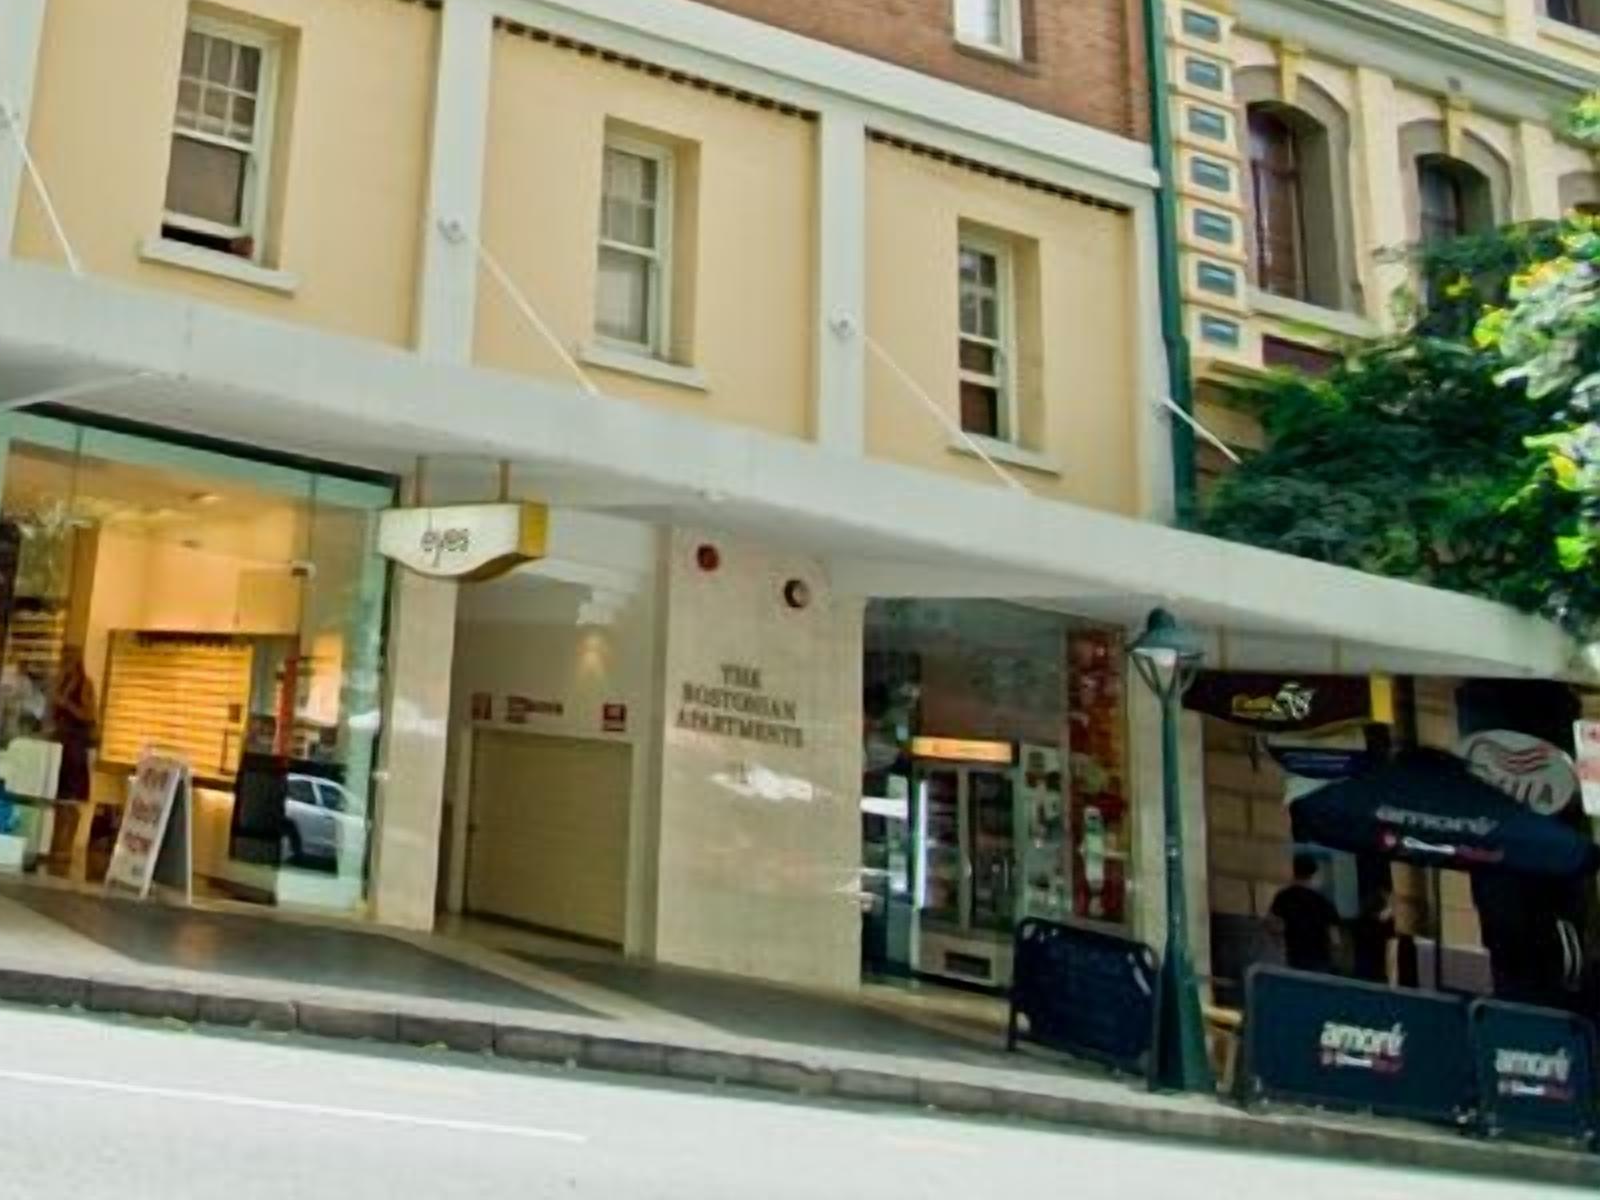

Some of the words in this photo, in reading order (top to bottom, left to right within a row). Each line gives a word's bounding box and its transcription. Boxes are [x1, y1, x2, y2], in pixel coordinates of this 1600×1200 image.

[420, 528, 470, 568] eyes
[720, 663, 762, 689] THE
[682, 680, 797, 722] BOSTONIAN
[673, 708, 804, 750] APARTMENTS
